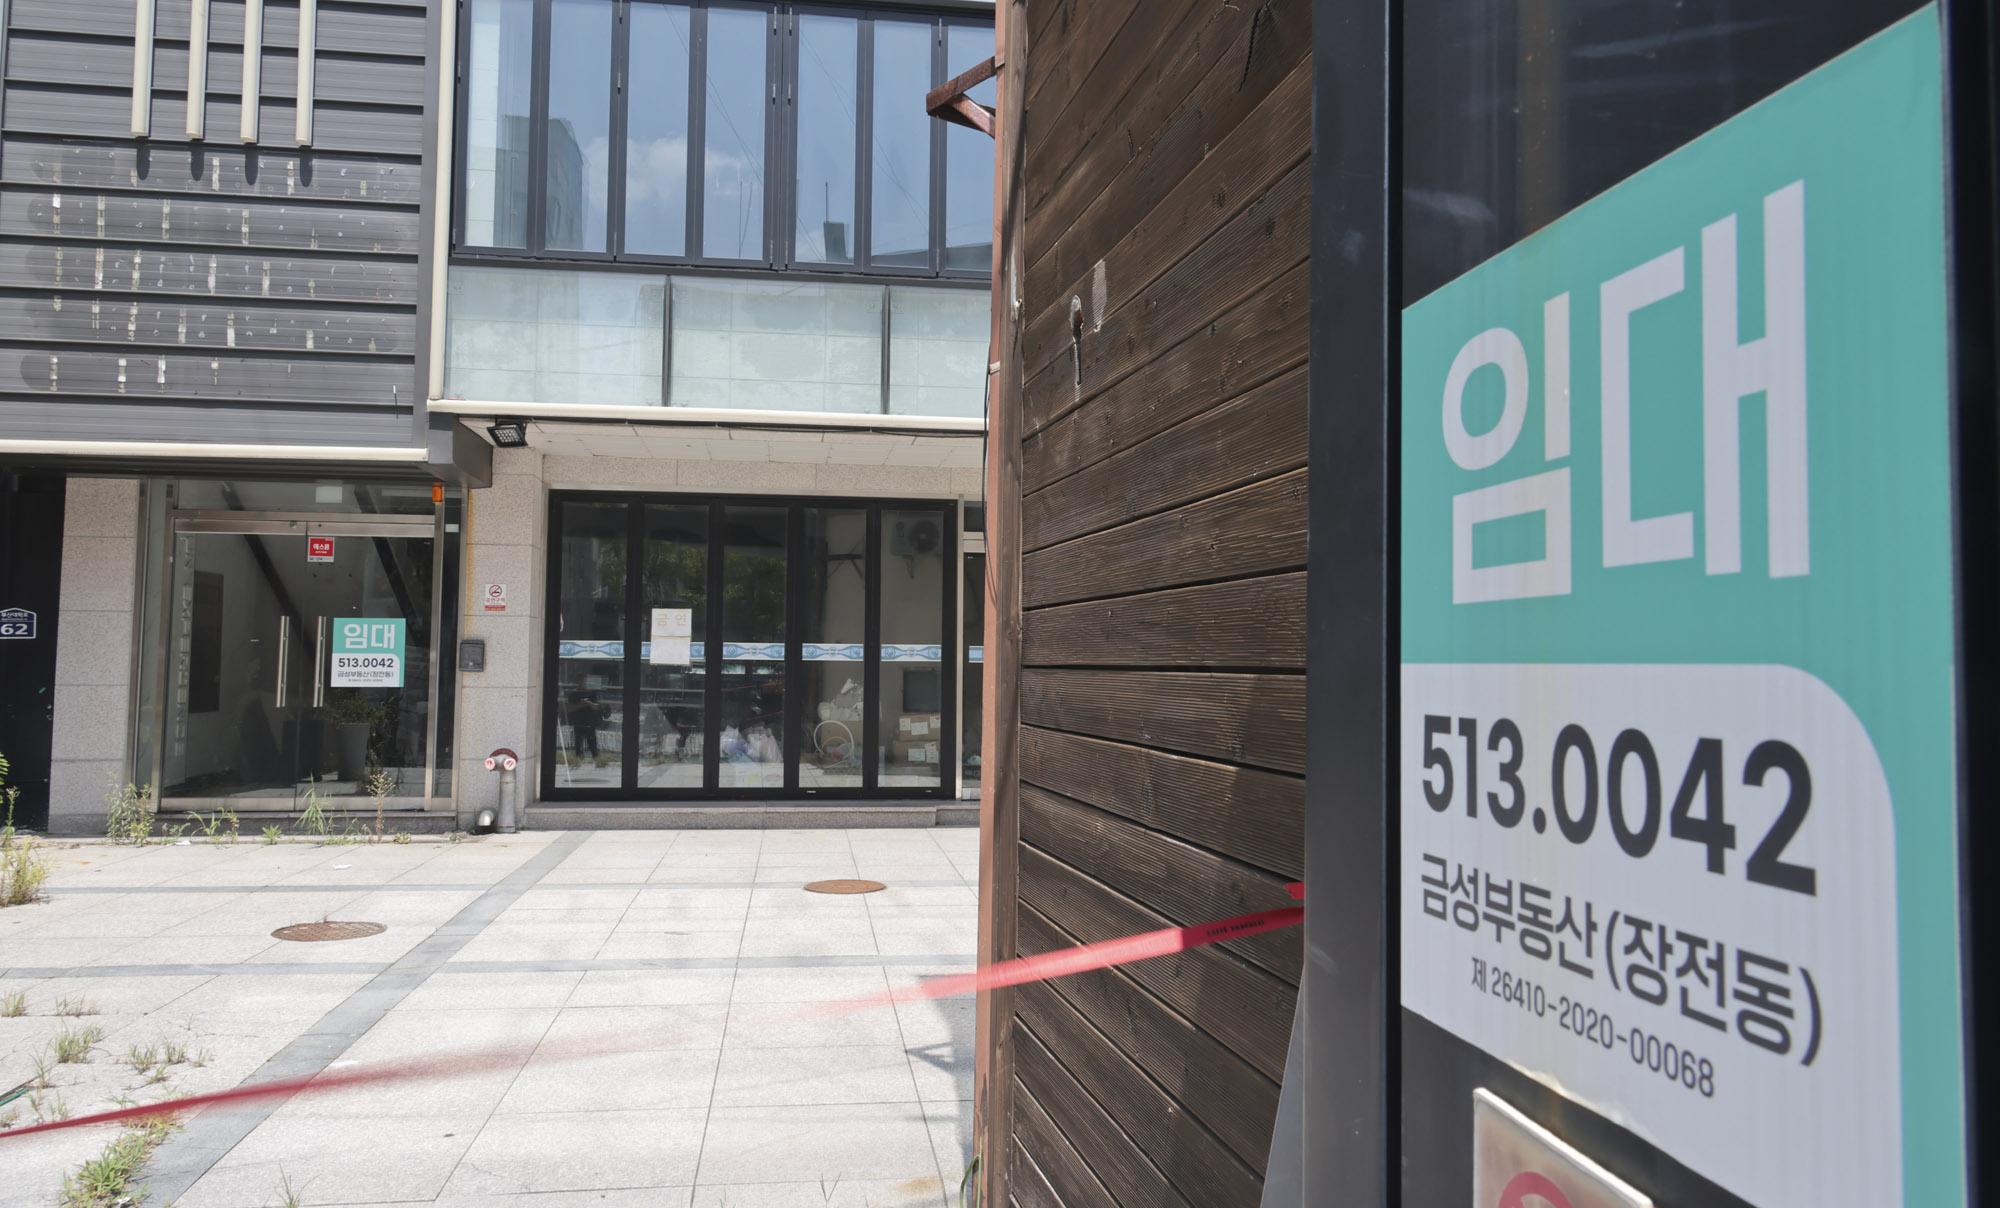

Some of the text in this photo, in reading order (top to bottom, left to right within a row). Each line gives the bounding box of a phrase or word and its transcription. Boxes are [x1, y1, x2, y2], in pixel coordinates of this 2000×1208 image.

[1442, 179, 1810, 605] 임대
[0, 623, 29, 635] 62
[338, 657, 394, 668] 513.0042
[344, 623, 396, 649] 임대
[1422, 713, 1818, 897] 513.0042
[1421, 852, 1823, 1067] 금성부동산(장전동)
[1471, 956, 1716, 1099] 제 26410-2020-00068
